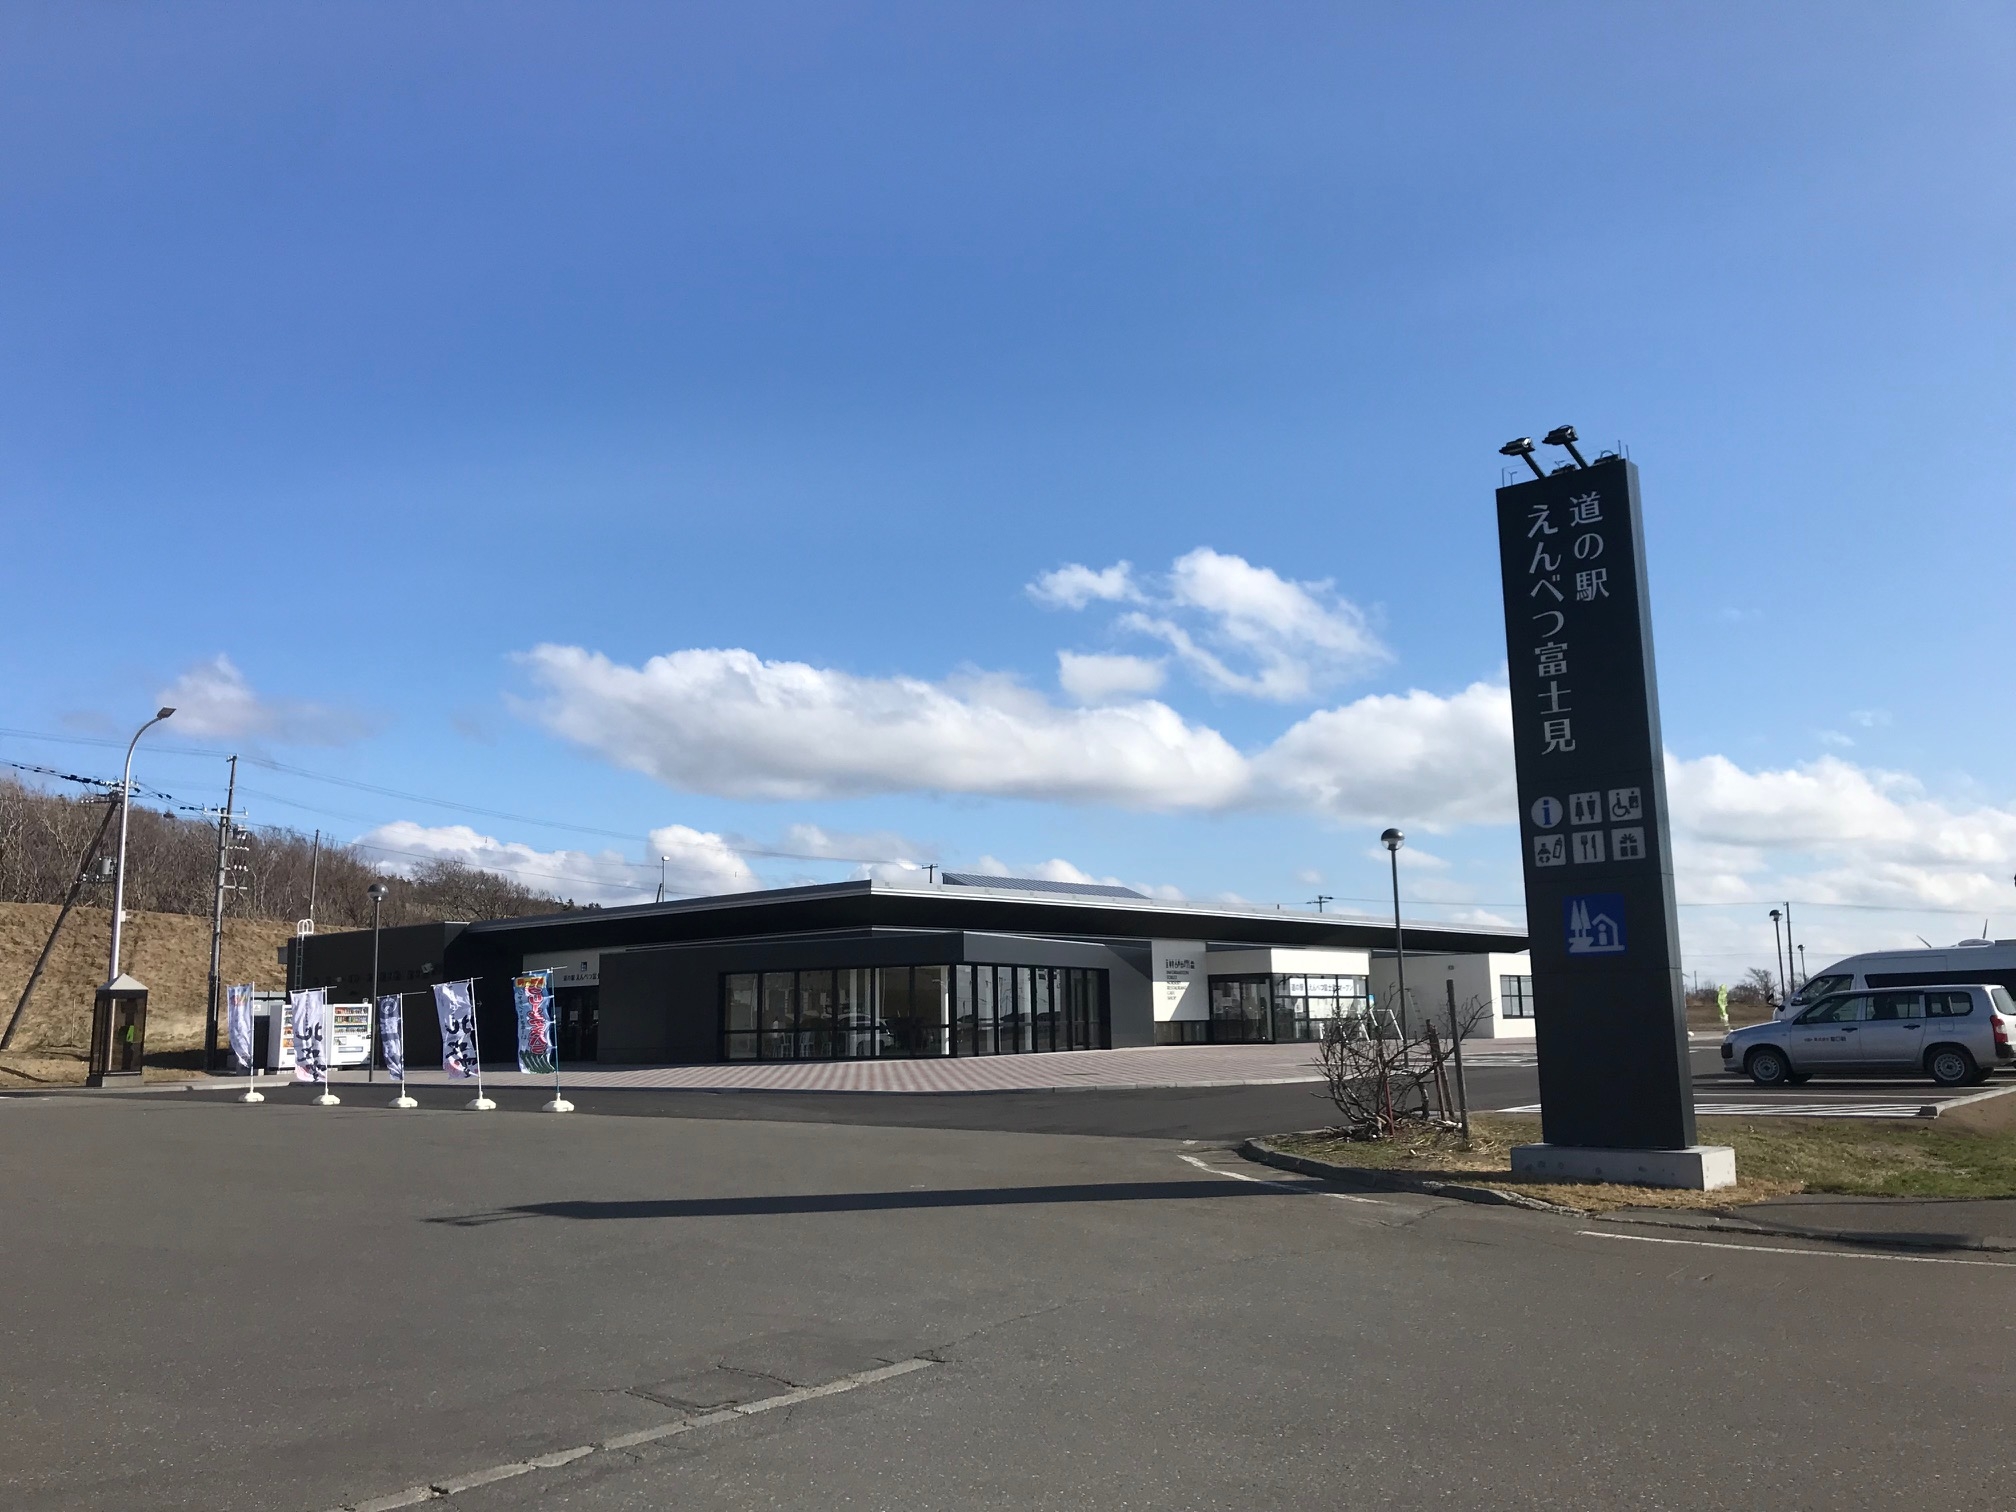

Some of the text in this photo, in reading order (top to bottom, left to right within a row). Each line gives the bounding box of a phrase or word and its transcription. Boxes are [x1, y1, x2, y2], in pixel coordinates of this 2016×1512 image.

[1527, 504, 1576, 755] えんべつ富士見
[1569, 490, 1610, 601] 道の駅
